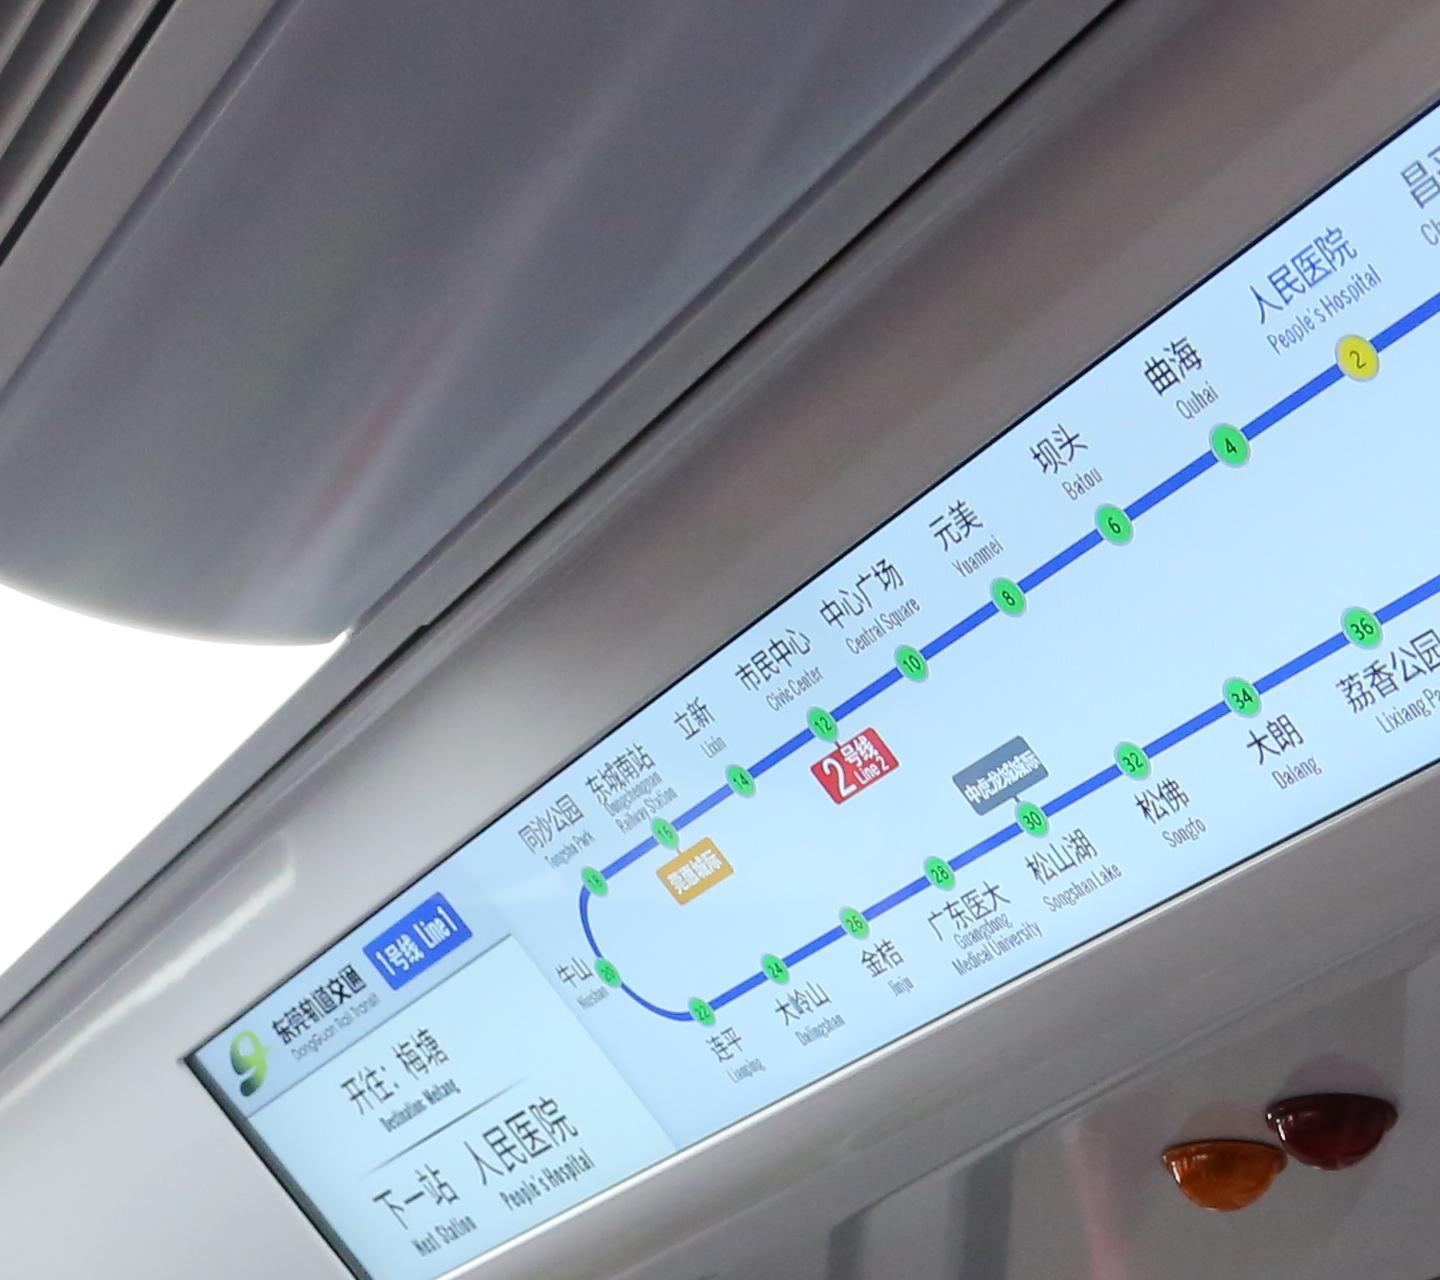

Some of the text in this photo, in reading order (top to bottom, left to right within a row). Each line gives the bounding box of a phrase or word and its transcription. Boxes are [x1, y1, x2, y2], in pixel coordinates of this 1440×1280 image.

[1248, 225, 1359, 325] 人民医院
[1319, 264, 1383, 323] Hospital
[1143, 335, 1204, 397] 曲海
[1349, 350, 1367, 370] 2
[1175, 380, 1221, 422] Quhai
[1028, 422, 1089, 477] 坝头
[1224, 436, 1237, 455] 4
[1061, 464, 1104, 503] Batou
[929, 499, 985, 552] 元美
[1108, 517, 1122, 534] 6
[952, 536, 1005, 579] Yuanmei
[818, 557, 906, 631] 中心广场
[1001, 590, 1016, 607] 8
[845, 597, 922, 657] Central Square
[1350, 616, 1375, 640] 36
[733, 627, 812, 694] 市民中心
[903, 655, 921, 673] 10
[764, 665, 824, 713] Civic Center
[1231, 687, 1253, 710] 34
[673, 696, 716, 742] 立新
[814, 716, 833, 733] 12
[1374, 691, 1433, 735] Lixiang
[1245, 714, 1305, 766] 大朗
[585, 742, 656, 804] 东城南站
[733, 773, 749, 789] 14
[854, 756, 891, 788] Line 2
[1122, 752, 1144, 772] 32
[1271, 755, 1323, 790] Dalang
[1023, 810, 1042, 831] 30
[1134, 777, 1190, 824] 松佛
[517, 793, 585, 855] 同沙公园
[931, 864, 950, 884] 28
[1024, 828, 1098, 885] 松山湖
[1042, 862, 1122, 913] Songshan Lake
[846, 915, 863, 932] 26
[927, 880, 1011, 942] 广东医大
[954, 911, 1013, 950] Guangdong
[376, 933, 424, 976] 1号线
[859, 939, 905, 981] 金桔
[951, 920, 1043, 977] Medical University
[554, 956, 594, 988] 牛山
[768, 963, 783, 979] 24
[272, 964, 367, 1045] 东莞轨道交通
[694, 1004, 710, 1021] 22
[775, 981, 832, 1027] 大岭山
[705, 1027, 744, 1063] 连平
[372, 1096, 579, 1230] 下一站 人民医院
[544, 1148, 596, 1192] Hospital
[411, 1215, 478, 1258] Next Station
